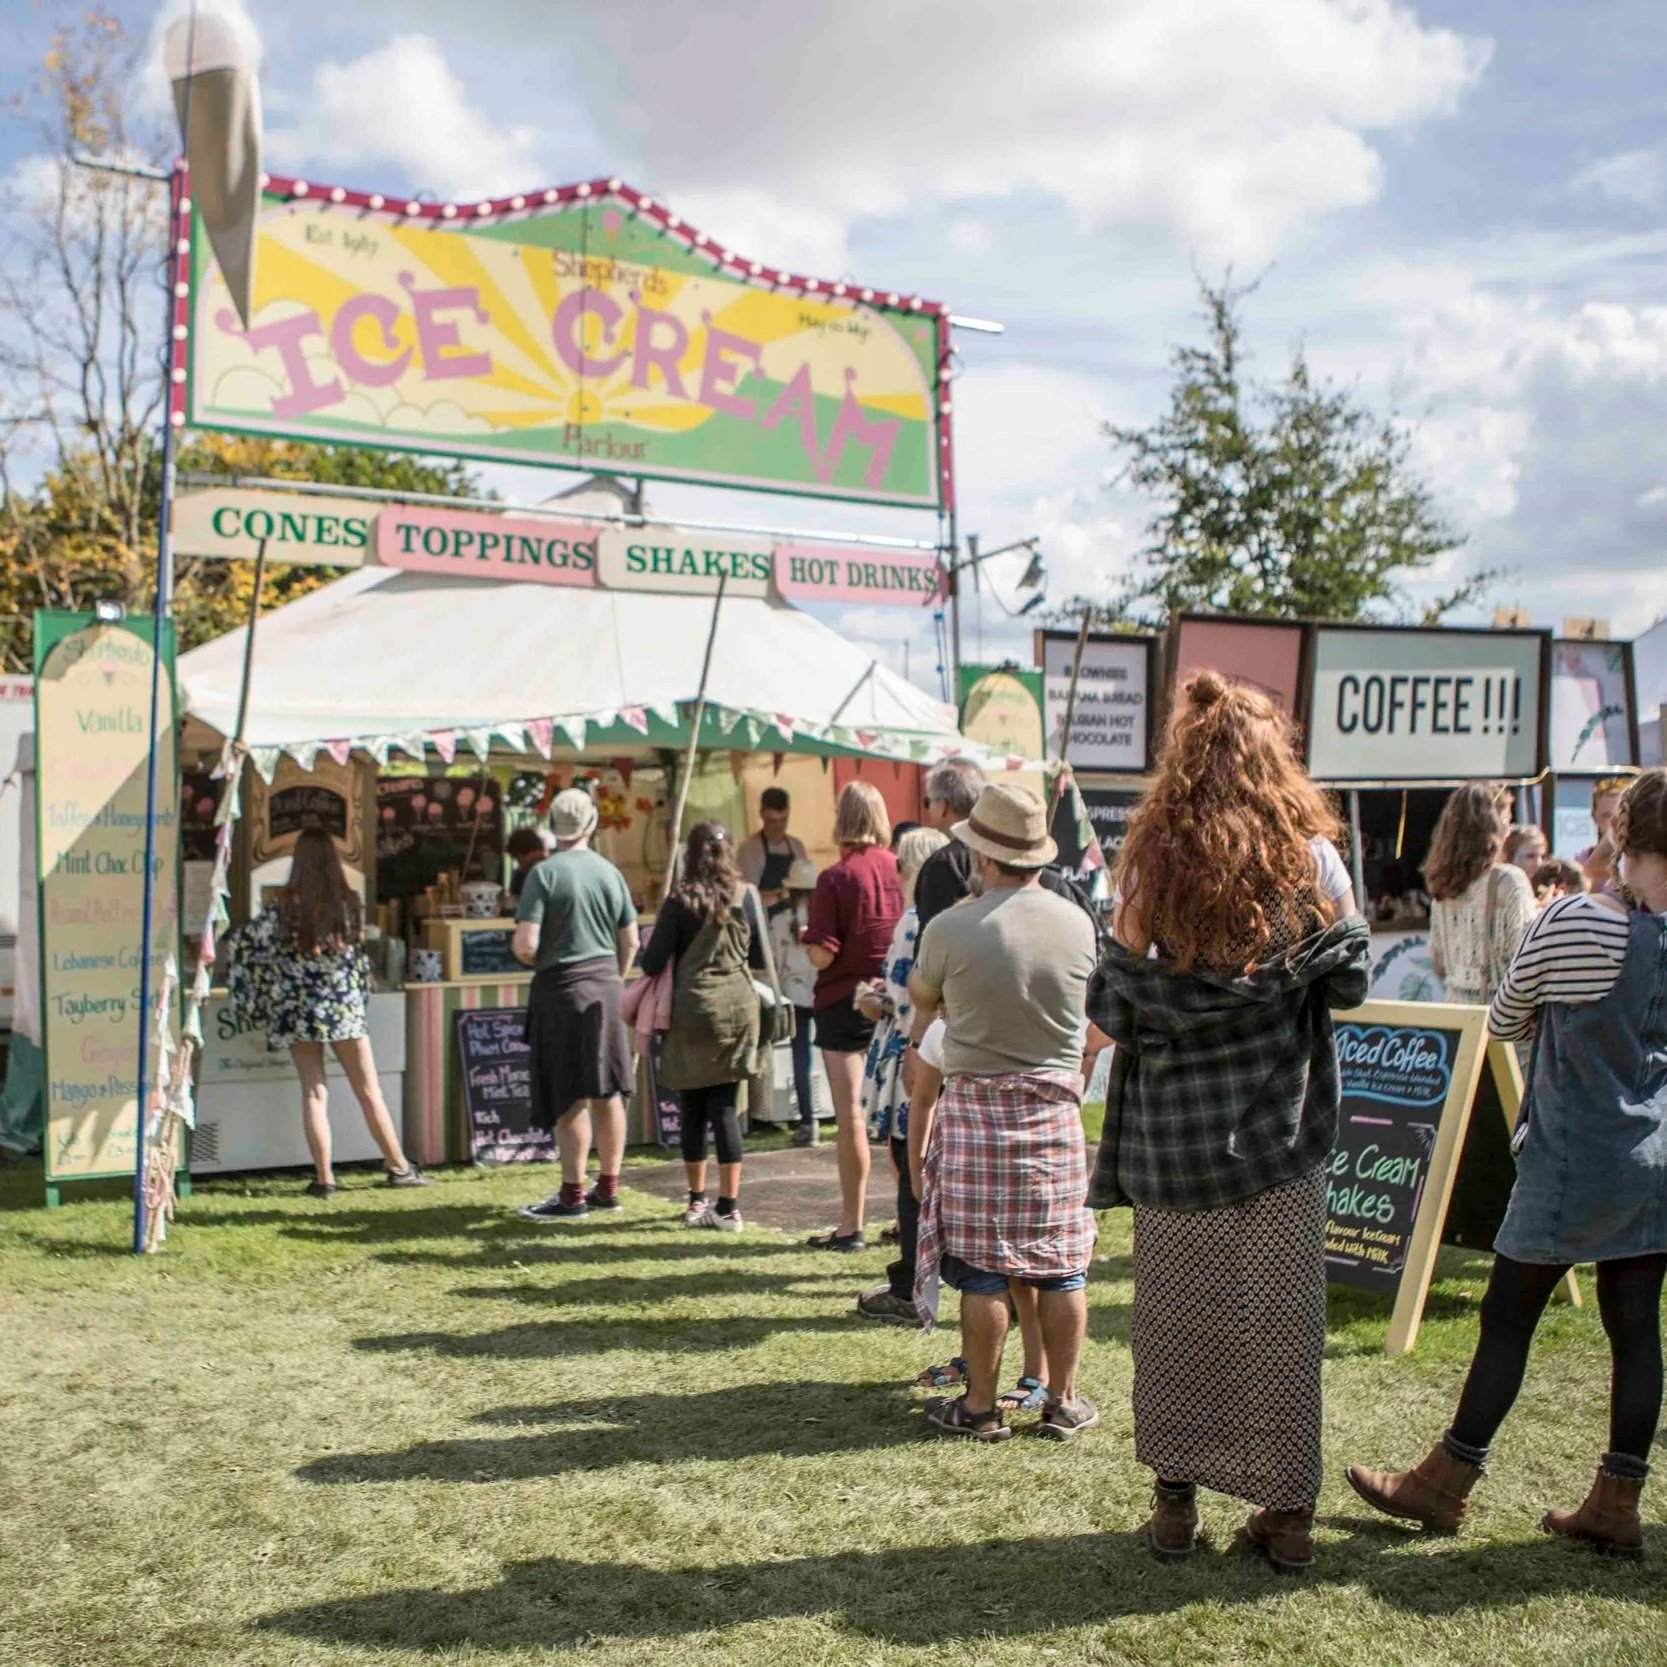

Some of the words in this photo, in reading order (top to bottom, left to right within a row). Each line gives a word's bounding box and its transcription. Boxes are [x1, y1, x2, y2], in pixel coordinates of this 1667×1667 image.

[553, 249, 668, 296] Shepherds
[214, 269, 494, 421] ICE
[551, 286, 901, 489] CREAM
[563, 423, 648, 461] Parlour
[212, 506, 368, 548] CONES
[396, 523, 594, 571] TOPPINGS
[626, 544, 770, 580] SHAKES
[790, 557, 839, 586] HOT
[846, 562, 940, 593] DRINKS
[1064, 665, 1128, 681] BOWNIES
[76, 706, 143, 734] Vanilla
[1109, 715, 1136, 728] HOT
[57, 849, 90, 875] Mint
[53, 952, 115, 973] Lebanese
[56, 995, 127, 1025] Tayberry
[1381, 1037, 1438, 1072] Coffee
[1325, 1181, 1395, 1224] hakes
